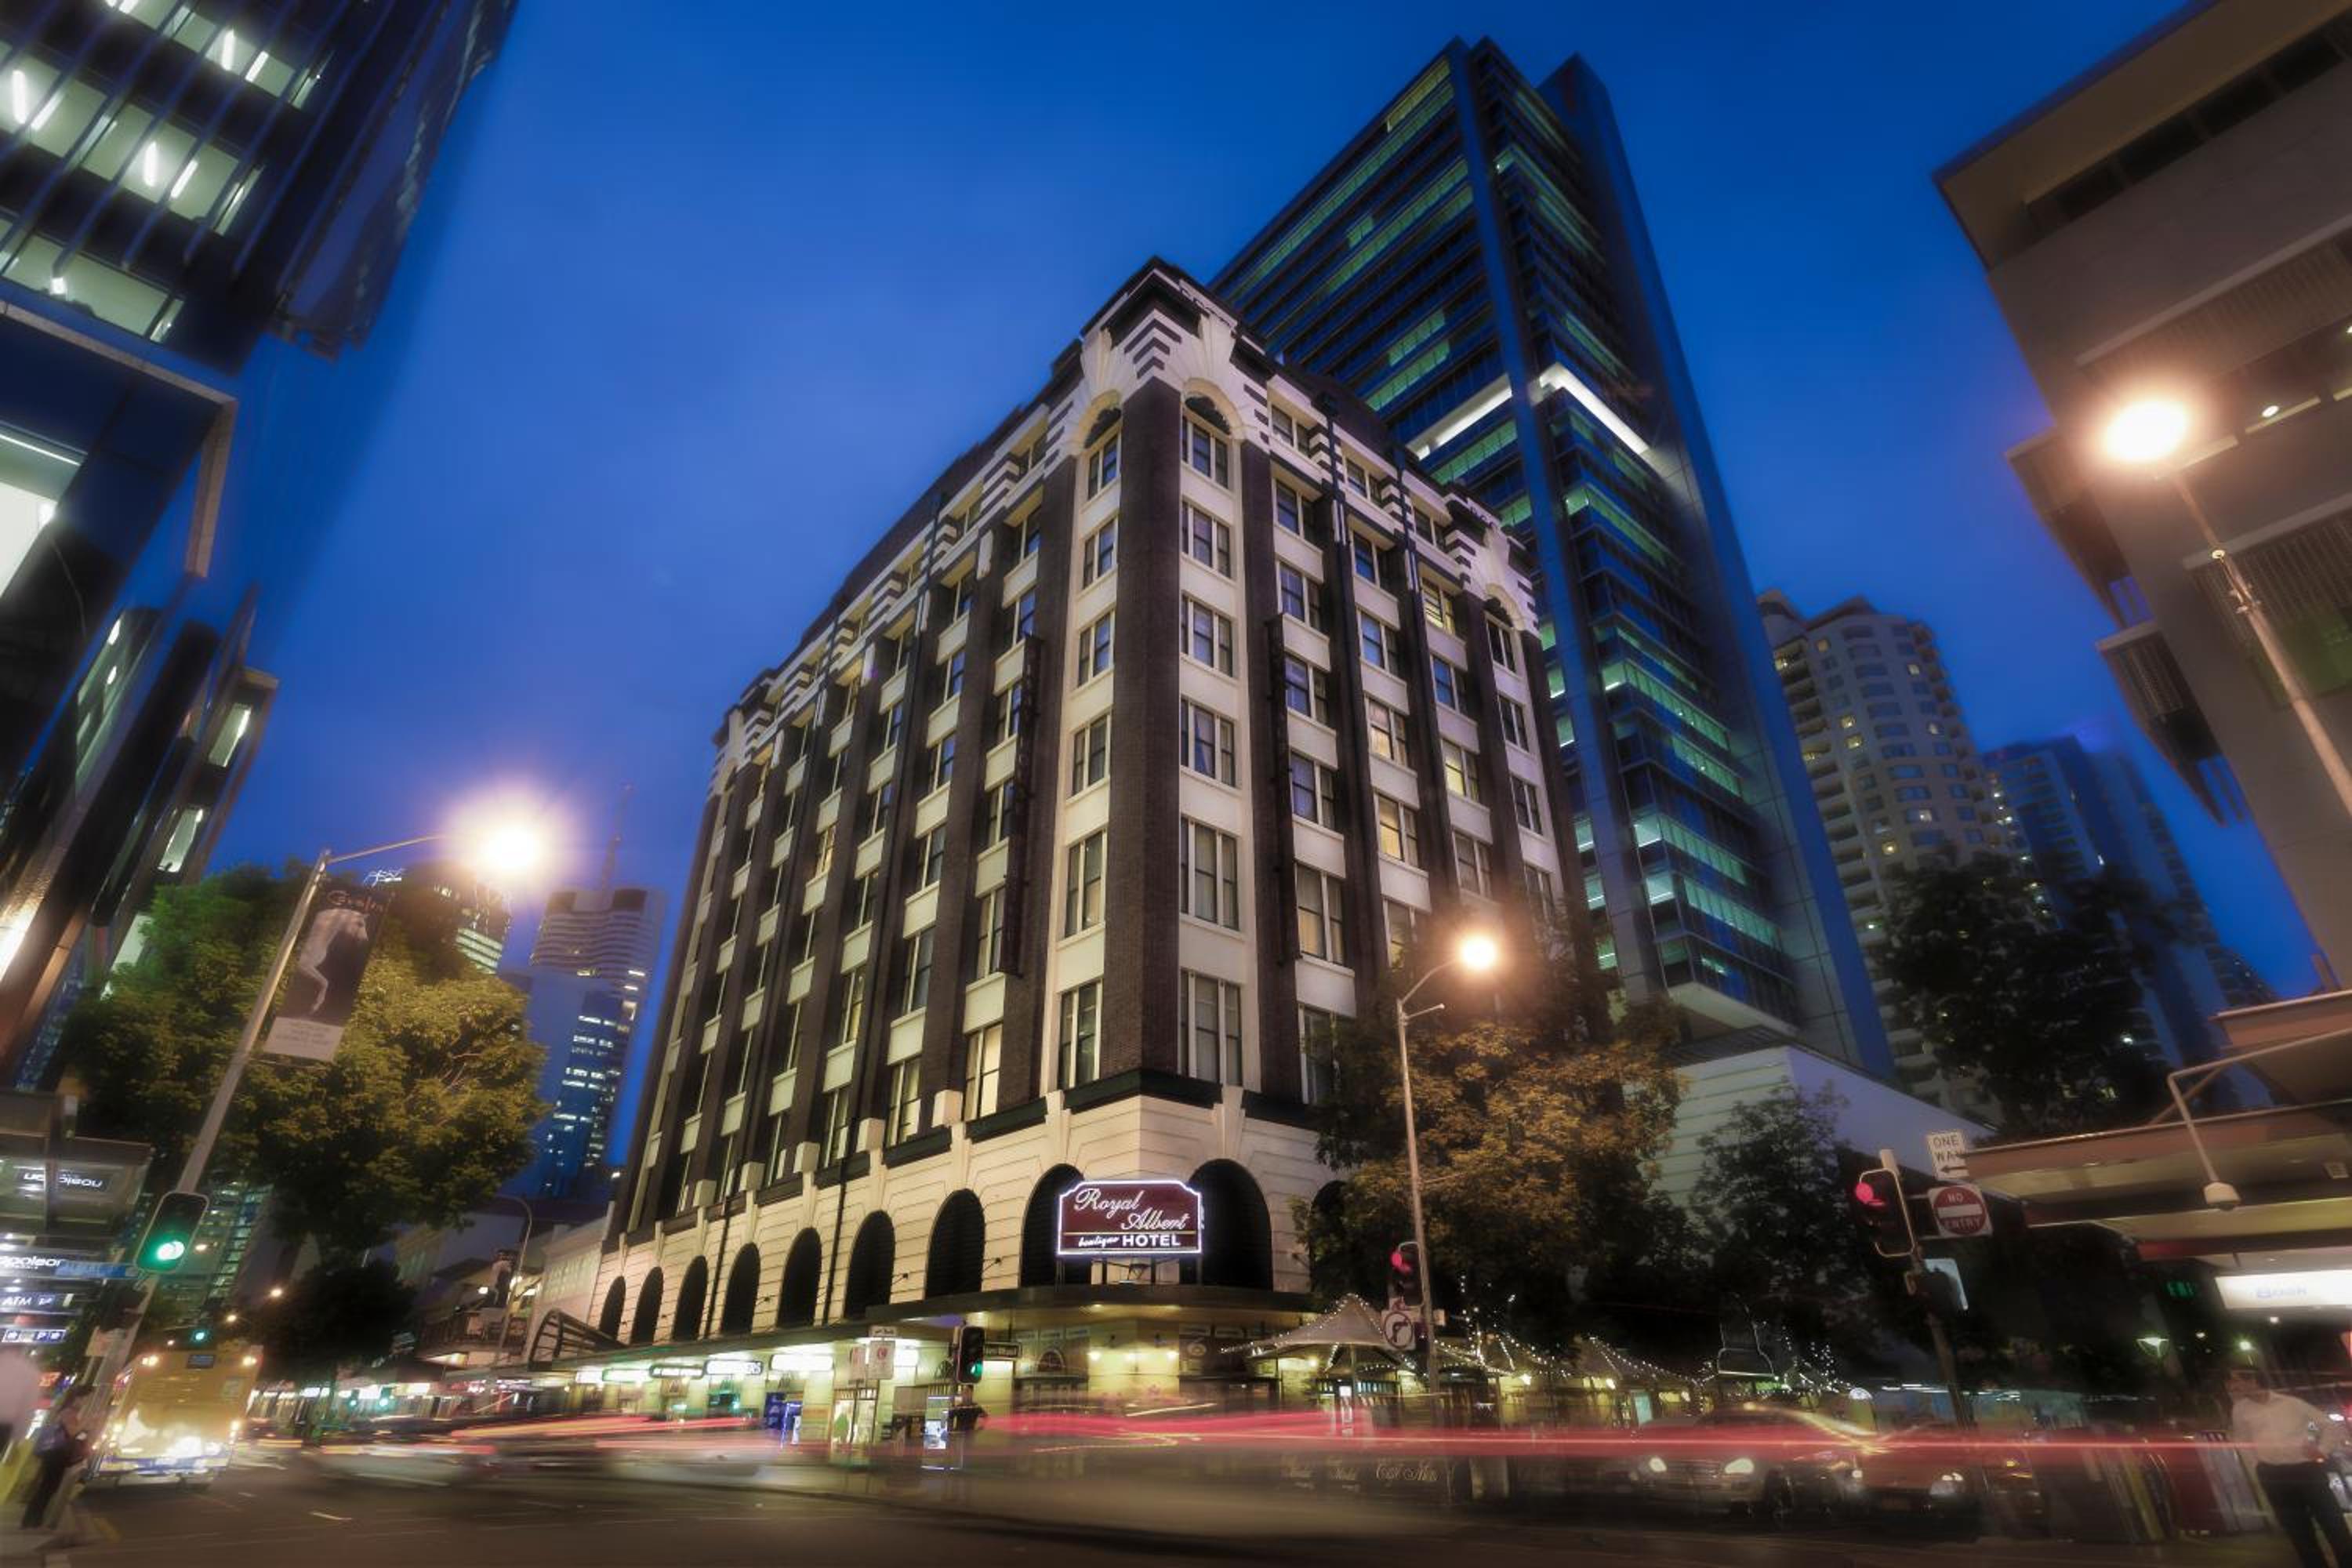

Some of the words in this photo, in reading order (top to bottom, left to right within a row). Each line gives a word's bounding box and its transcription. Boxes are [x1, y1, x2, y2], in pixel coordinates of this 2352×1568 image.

[1933, 1134, 1958, 1148] ONE
[1074, 1189, 1145, 1218] Royal
[1947, 1192, 1964, 1203] NO
[1120, 1207, 1191, 1231] Albert
[1121, 1234, 1181, 1247] HOTEL
[2, 1296, 32, 1306] ATM
